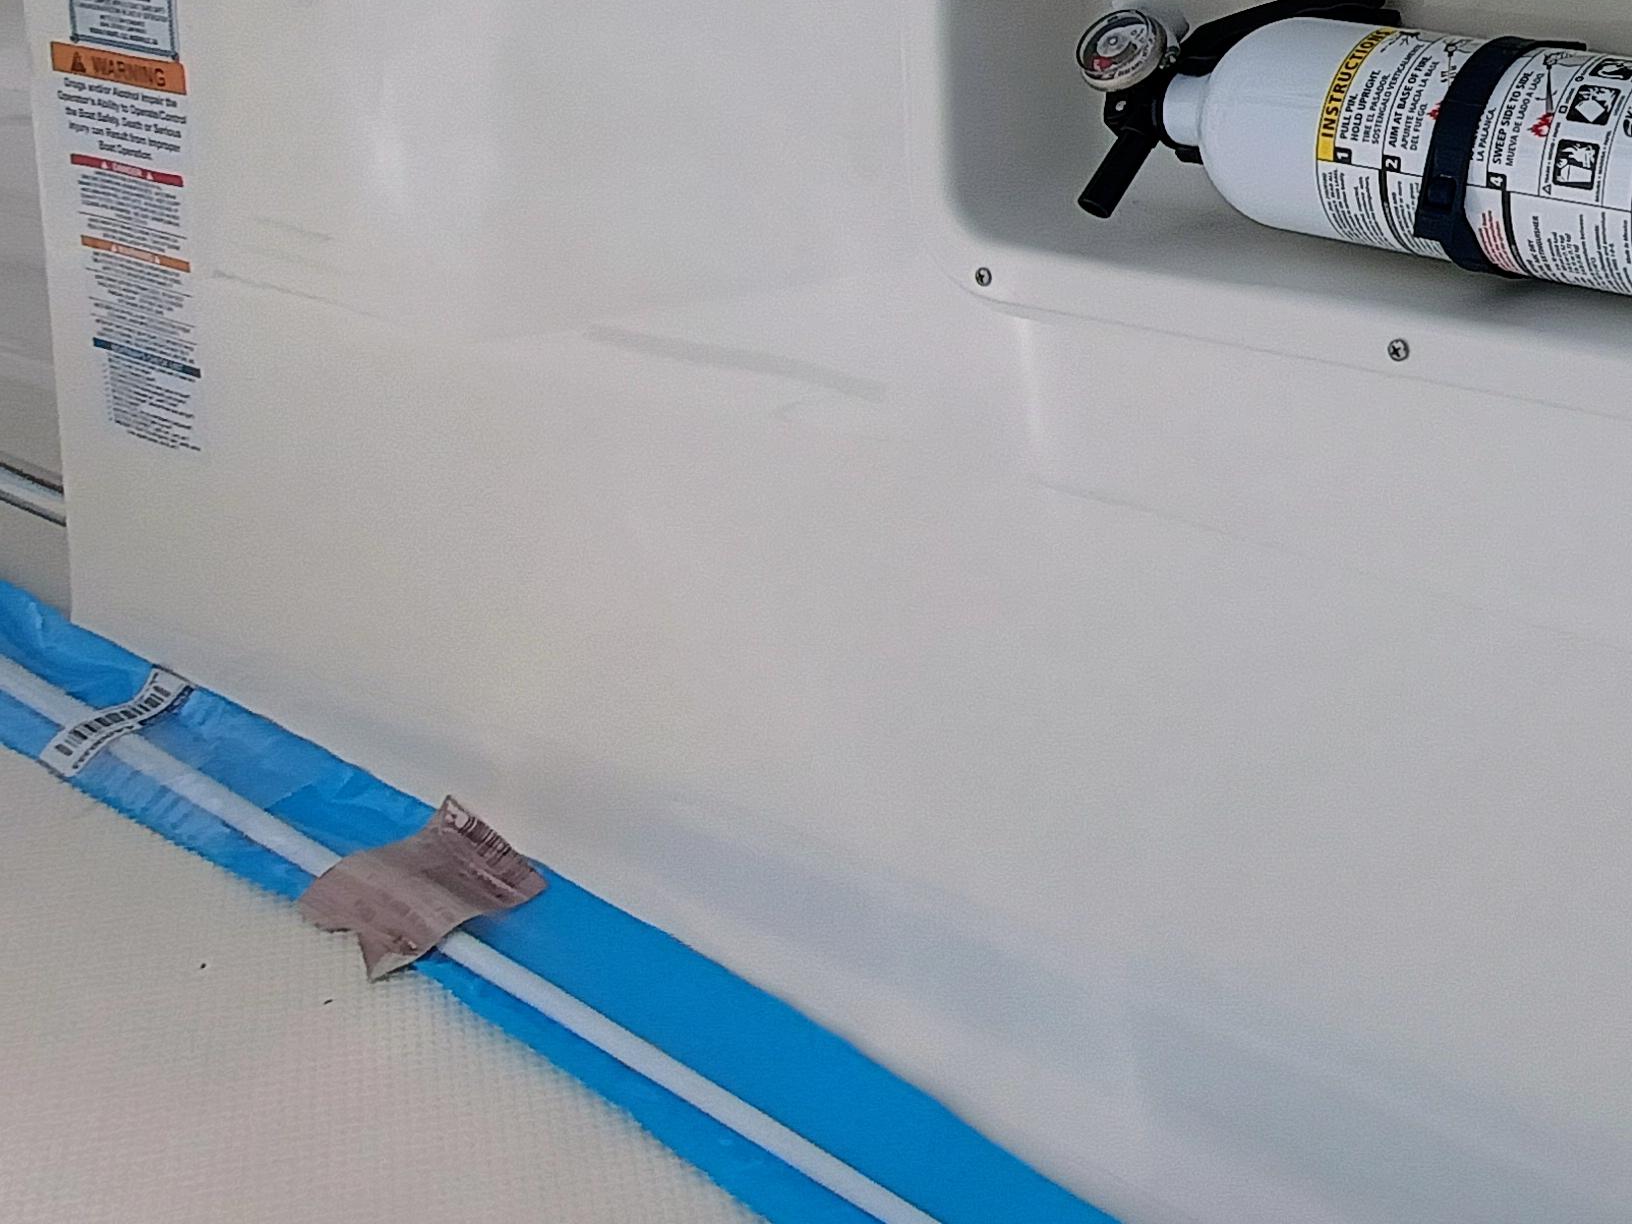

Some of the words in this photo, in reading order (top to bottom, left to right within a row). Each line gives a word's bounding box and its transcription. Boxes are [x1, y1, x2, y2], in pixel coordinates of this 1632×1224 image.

[92, 56, 166, 87] WARNING
[1407, 72, 1420, 87] OF
[1321, 29, 1391, 138] INSTRUCTIONS
[1350, 113, 1363, 141] HOLD
[1358, 69, 1382, 110] UPRIGHT.
[1397, 87, 1411, 110] BASE
[1339, 111, 1351, 140] PULL
[1347, 93, 1358, 113] PIN.
[1366, 113, 1375, 122] EL
[1394, 112, 1404, 125] AT
[1400, 114, 1414, 150] APUNTE
[1409, 89, 1422, 115] HACIA
[1418, 77, 1429, 89] LA
[1516, 98, 1531, 121] LADO
[1362, 123, 1371, 143] TIRE
[1388, 126, 1400, 148] AIM
[1492, 127, 1507, 165] SWEEP
[1503, 101, 1516, 126] SIDE
[1510, 89, 1522, 103] TO
[1512, 120, 1522, 135] DE
[1410, 131, 1420, 151] DEL
[1505, 135, 1519, 167] MUEVA
[1336, 151, 1349, 161] 1
[1385, 158, 1399, 170] 2
[1477, 148, 1486, 162] LA
[1489, 175, 1504, 188] 4
